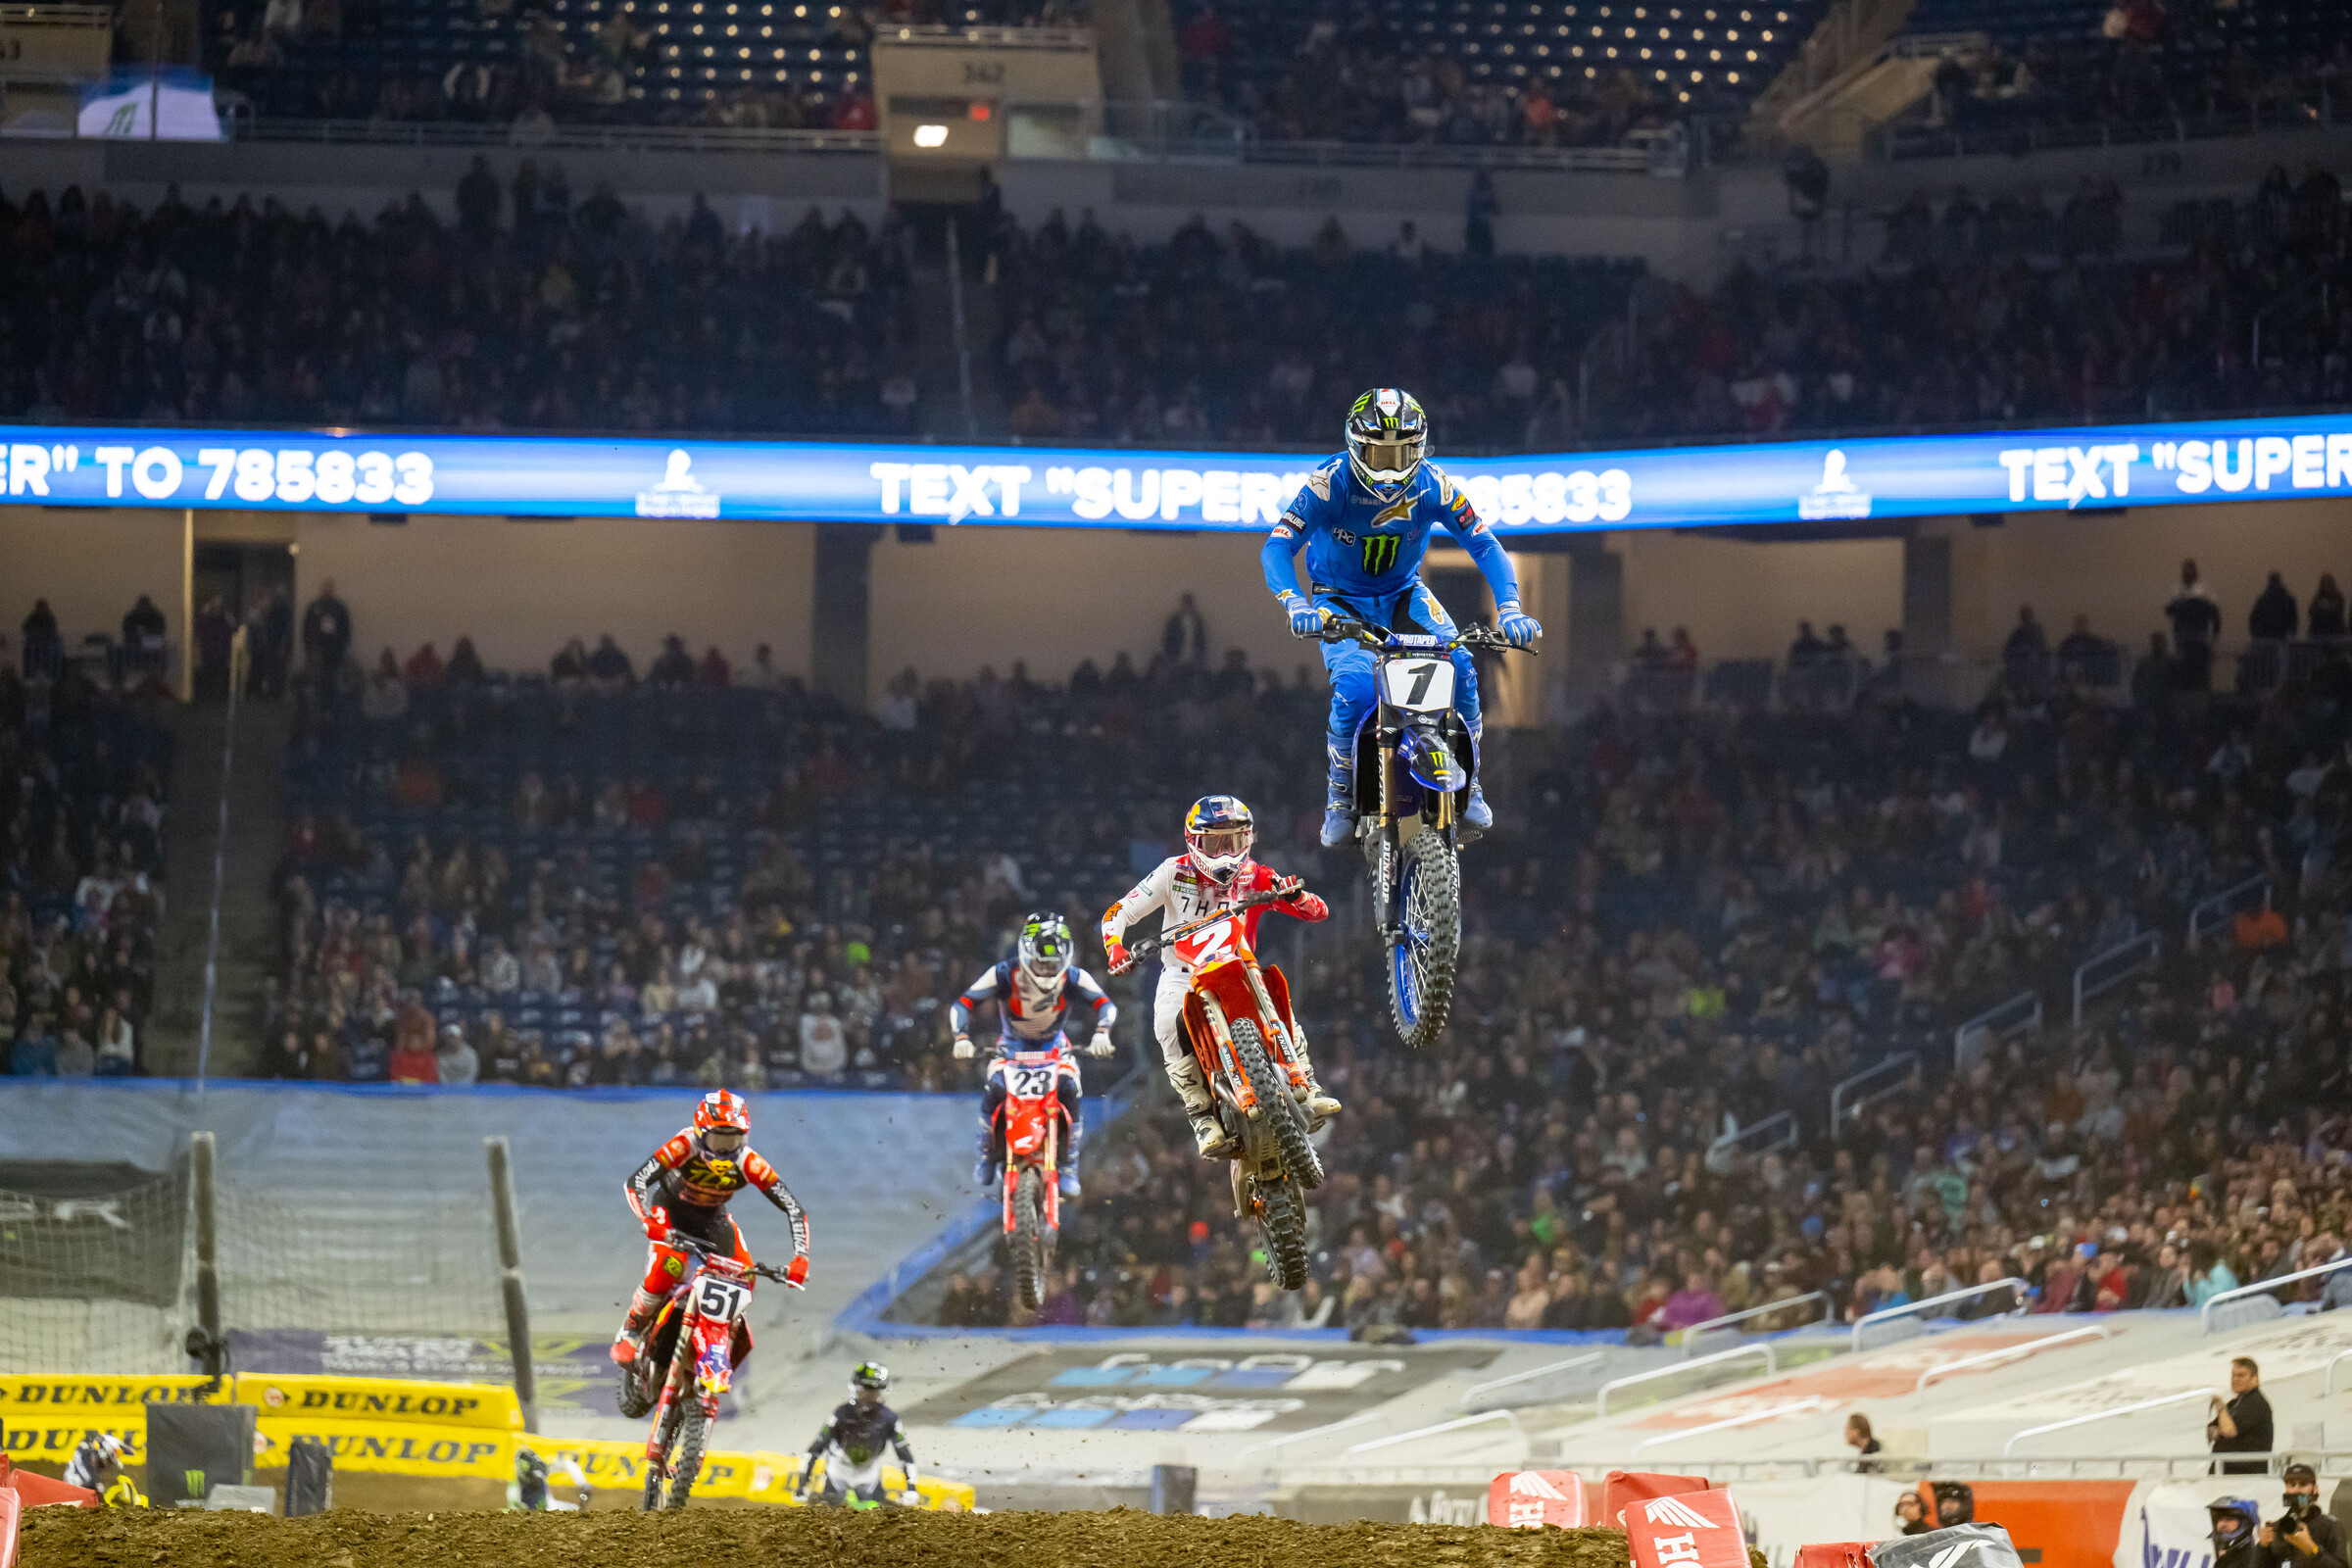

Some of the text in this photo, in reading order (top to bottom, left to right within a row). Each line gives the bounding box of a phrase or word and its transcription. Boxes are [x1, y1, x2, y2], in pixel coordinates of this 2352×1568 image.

[95, 446, 183, 500] TO
[197, 447, 434, 506] 785833
[869, 462, 1032, 525] TEXT
[1450, 467, 1633, 526] 85833
[1998, 443, 2140, 511] TEXT
[1333, 526, 1354, 545] PPG
[1405, 662, 1439, 706] 1
[1382, 839, 1392, 905] DUNLOP
[1192, 919, 1233, 966] 2
[1013, 1069, 1054, 1097] 23
[700, 1280, 741, 1321] 51
[299, 1390, 478, 1416] DUNLOP
